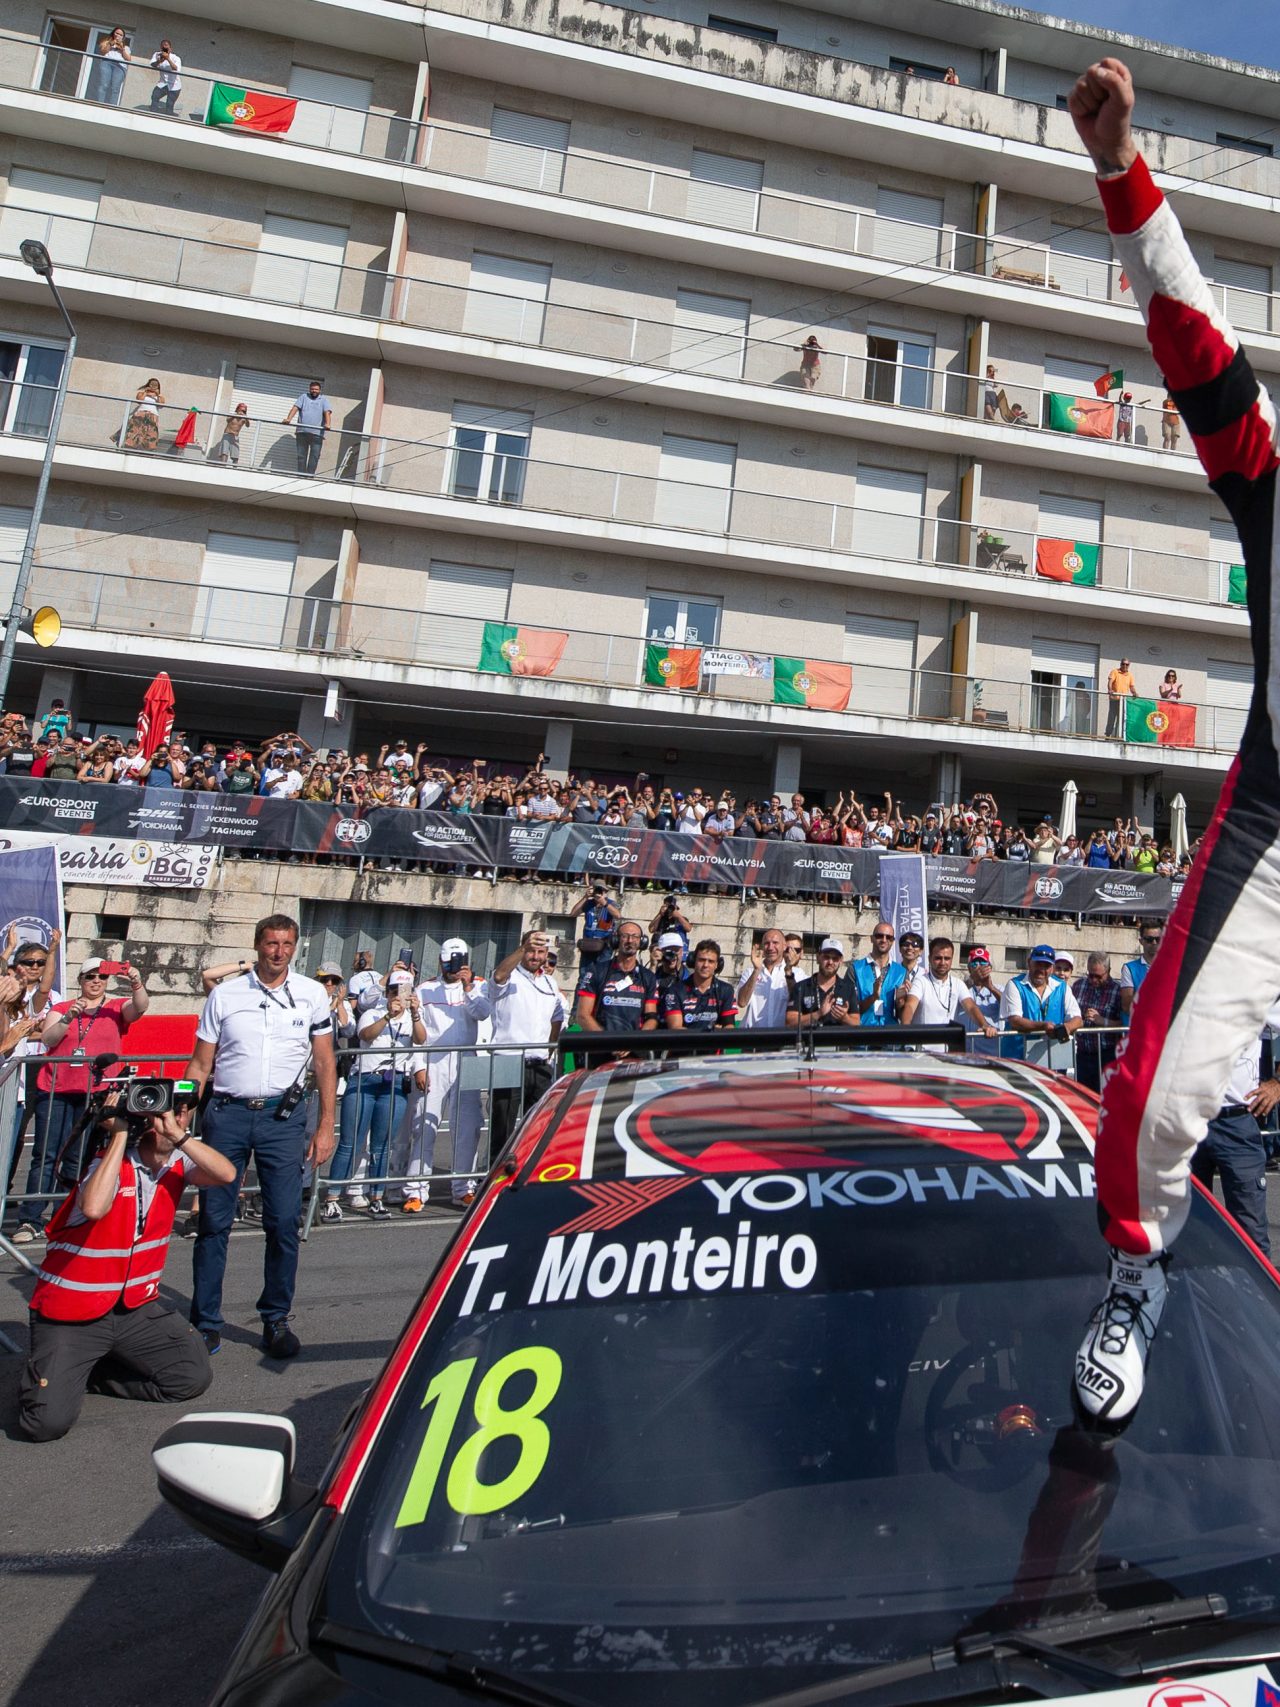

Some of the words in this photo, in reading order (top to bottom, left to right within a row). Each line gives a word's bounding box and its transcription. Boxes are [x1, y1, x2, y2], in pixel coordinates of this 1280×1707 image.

[710, 652, 742, 660] TIAGO
[19, 796, 99, 810] EUROSPORT
[56, 809, 94, 818] EVENTS
[136, 808, 179, 819] DHL
[141, 820, 183, 831] YOKOHAMA
[205, 816, 259, 826] JVCKENWOOD
[337, 822, 368, 839] FIA
[437, 826, 466, 836] ACTION
[588, 850, 639, 862] OSCARO
[671, 853, 767, 868] #ROADTOMALAYSIA
[154, 857, 188, 876] BG
[793, 859, 854, 872] EUROSPORT
[822, 870, 851, 879] EVENTS
[1114, 884, 1137, 892] ACTION
[458, 1244, 508, 1317] T.
[528, 1220, 818, 1305] Monteiro
[1117, 1271, 1142, 1282] OMP
[394, 1345, 562, 1529] 18
